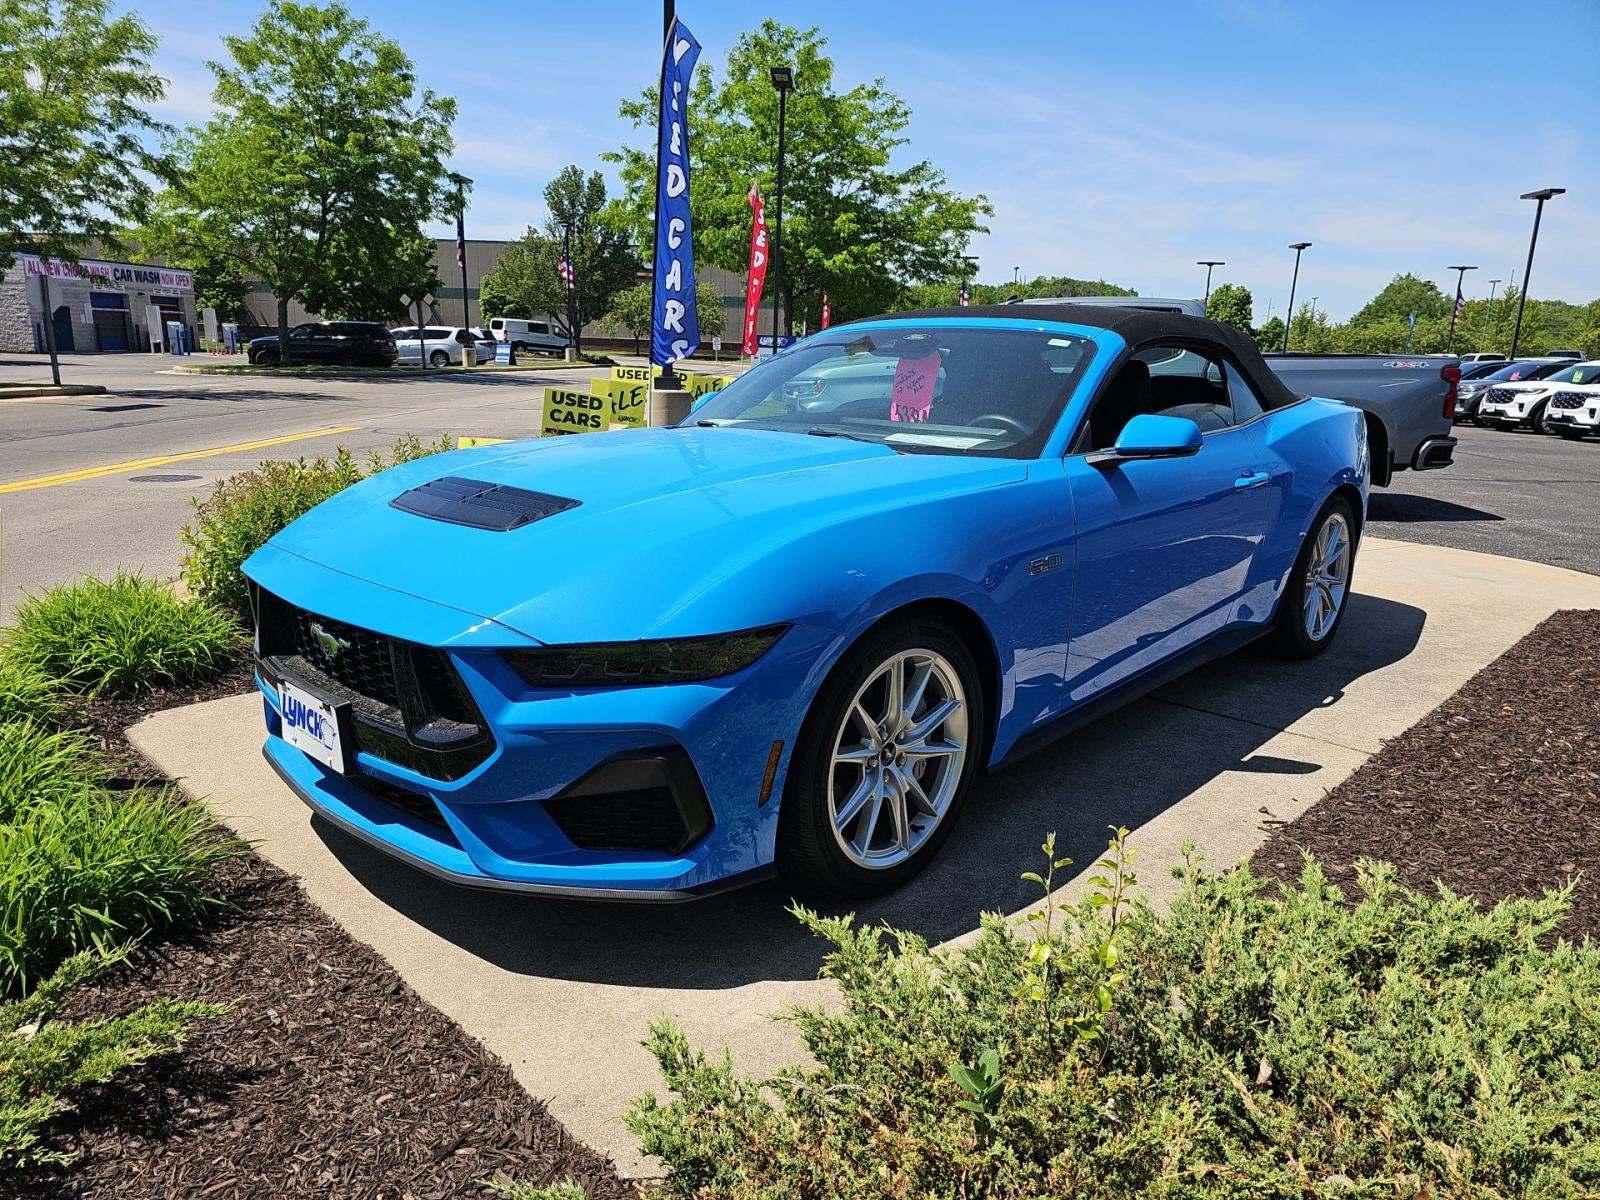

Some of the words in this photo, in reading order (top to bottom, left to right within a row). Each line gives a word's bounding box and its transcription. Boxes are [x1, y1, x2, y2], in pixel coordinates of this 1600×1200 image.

[28, 260, 43, 275] ALL
[113, 267, 133, 282] CAR
[134, 269, 160, 285] WASH
[161, 272, 175, 286] NOW
[174, 274, 190, 288] OPEN
[663, 217, 690, 364] CARS
[551, 390, 603, 410] USED
[549, 408, 601, 428] CARS
[1029, 553, 1060, 576] 5.0
[282, 693, 324, 740] LYNCH
